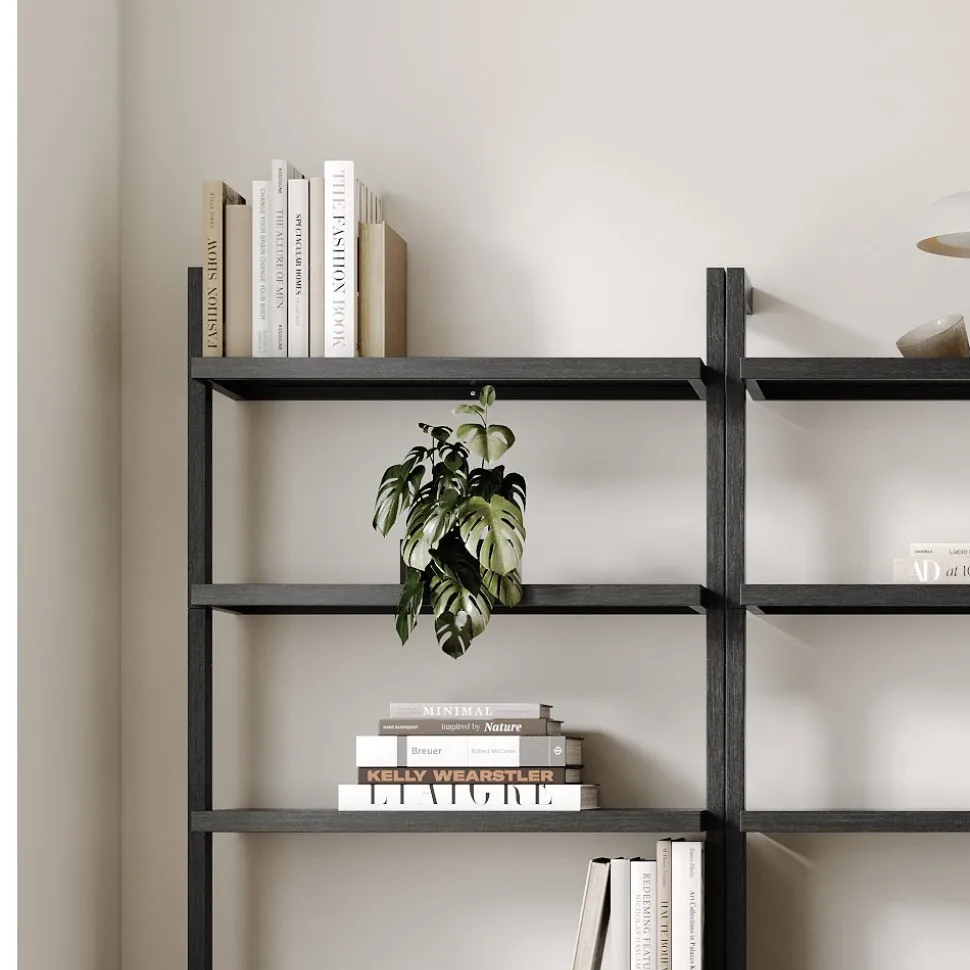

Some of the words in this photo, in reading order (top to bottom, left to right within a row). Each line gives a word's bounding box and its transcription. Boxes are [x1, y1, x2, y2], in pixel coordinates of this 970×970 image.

[332, 170, 346, 209] THE
[276, 209, 284, 229] THE
[207, 238, 218, 280] SHOW
[276, 230, 284, 272] ALLURE
[332, 215, 346, 294] FASHION
[276, 273, 284, 285] OF
[276, 287, 284, 309] MEN
[207, 286, 218, 348] FASHION
[332, 299, 346, 348] BOOK
[910, 560, 940, 582] AD
[946, 563, 959, 577] at
[423, 706, 493, 716] MINIMAL
[441, 722, 471, 731] Inspired
[471, 722, 480, 731] by
[484, 722, 522, 732] Nature
[411, 747, 442, 755] Breuer
[367, 769, 427, 782] KELLY
[433, 769, 554, 782] WEARSTLER
[642, 873, 651, 934] REDEEMING
[660, 900, 669, 938] HAUTE
